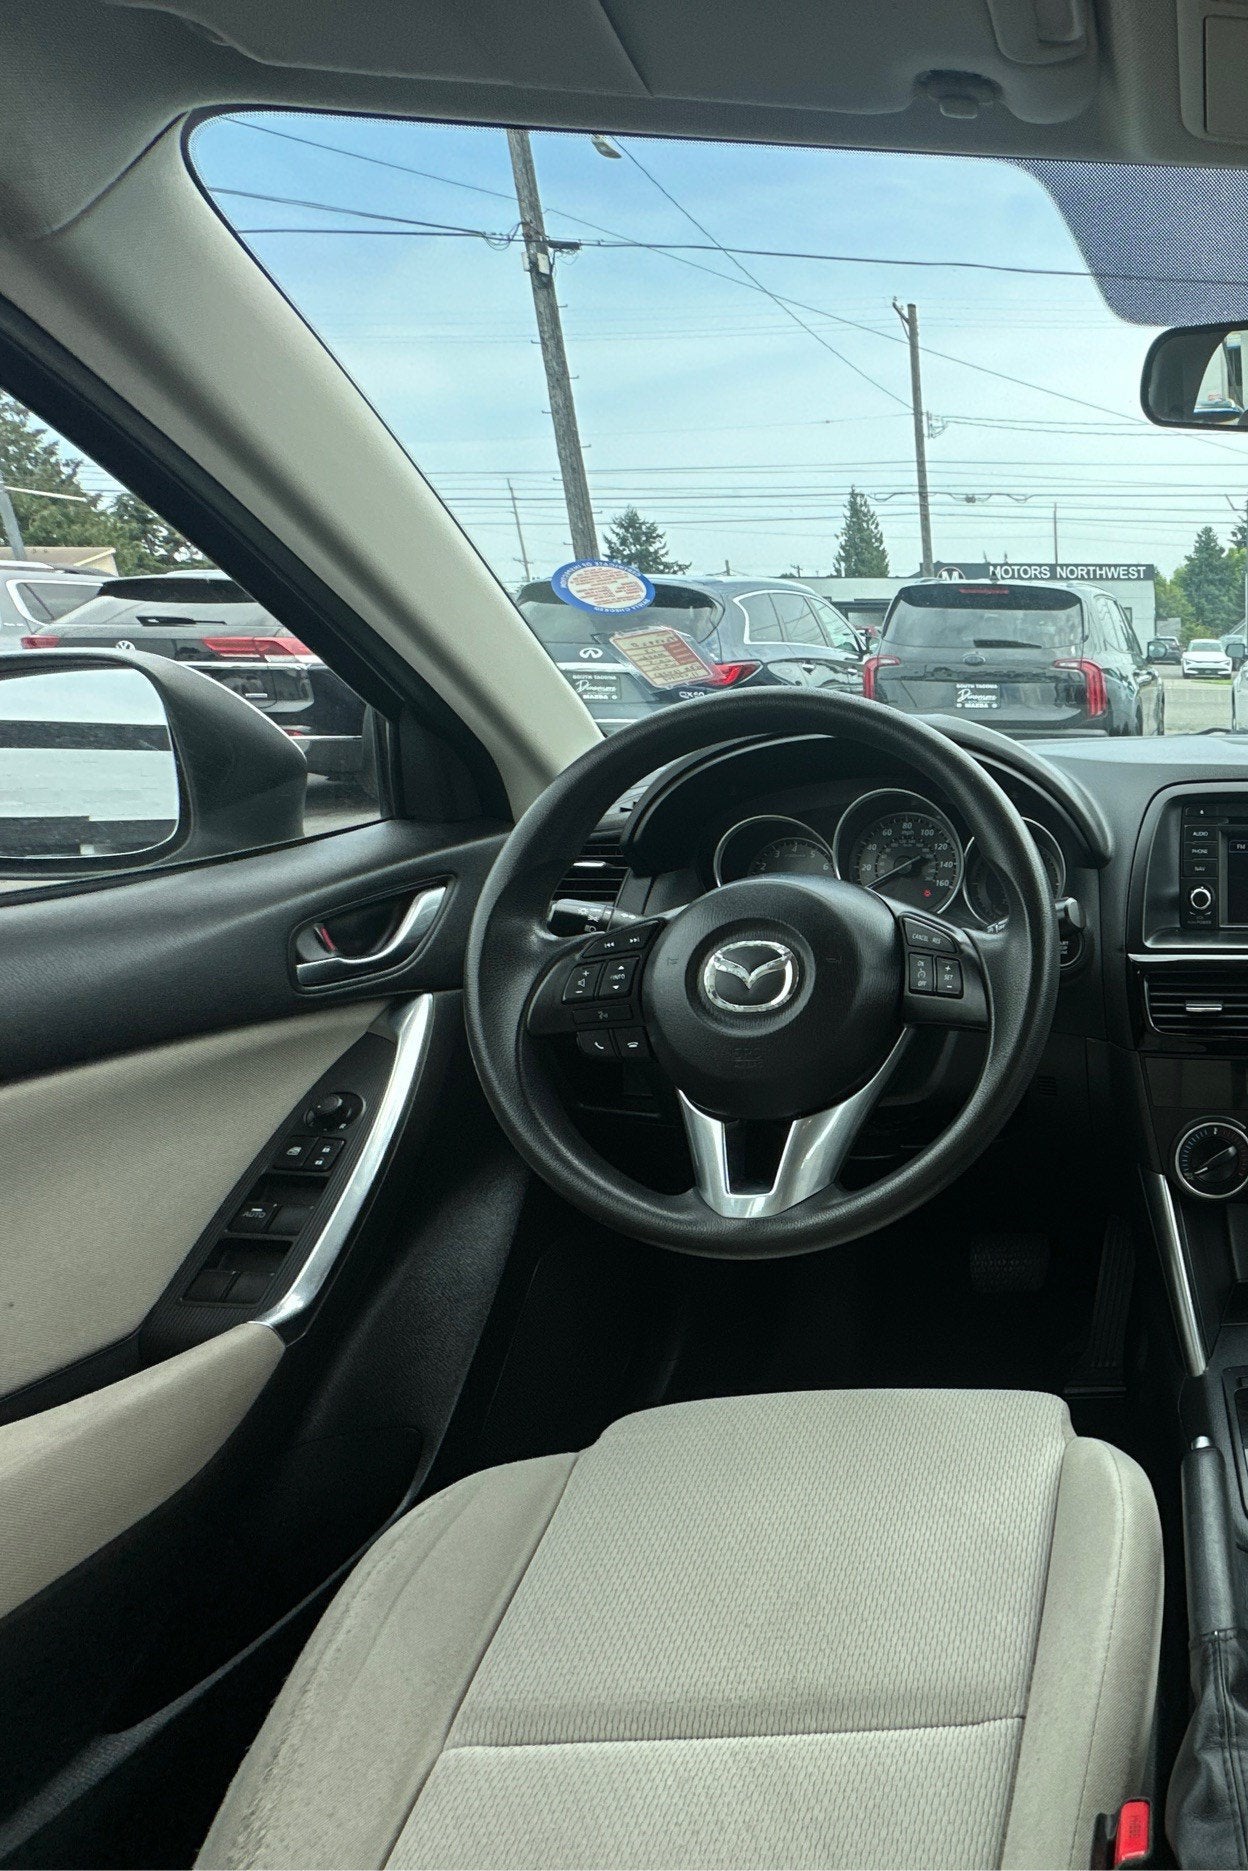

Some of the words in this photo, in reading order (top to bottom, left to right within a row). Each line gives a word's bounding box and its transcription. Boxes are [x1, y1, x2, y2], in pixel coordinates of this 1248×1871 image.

[989, 565, 1050, 580] MOTORS
[1056, 566, 1146, 580] NORTHWEST
[866, 843, 877, 851] 40
[936, 879, 949, 887] 160
[912, 933, 929, 942] CANCEL
